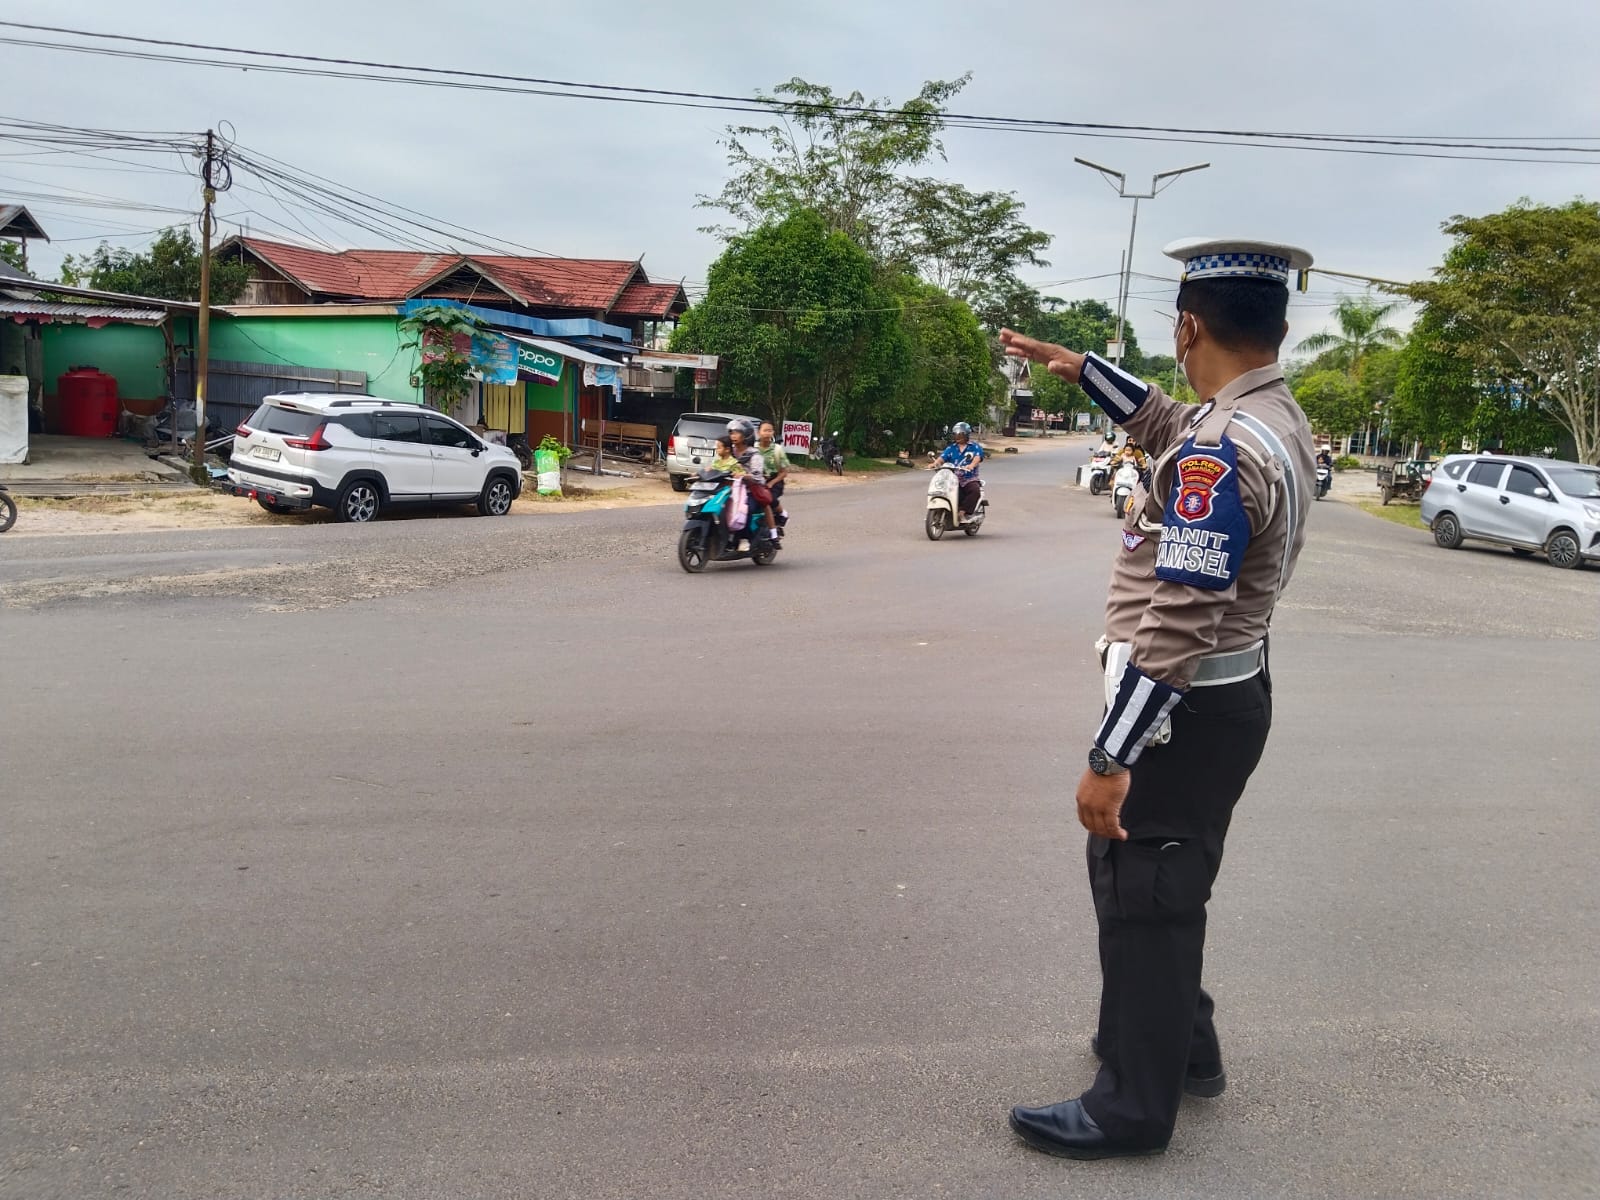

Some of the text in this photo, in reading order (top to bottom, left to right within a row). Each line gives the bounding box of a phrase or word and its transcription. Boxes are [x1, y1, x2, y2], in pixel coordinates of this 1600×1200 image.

[784, 424, 811, 432] BENGKEL
[784, 434, 810, 448] MOTOR
[1181, 460, 1221, 472] POLRES
